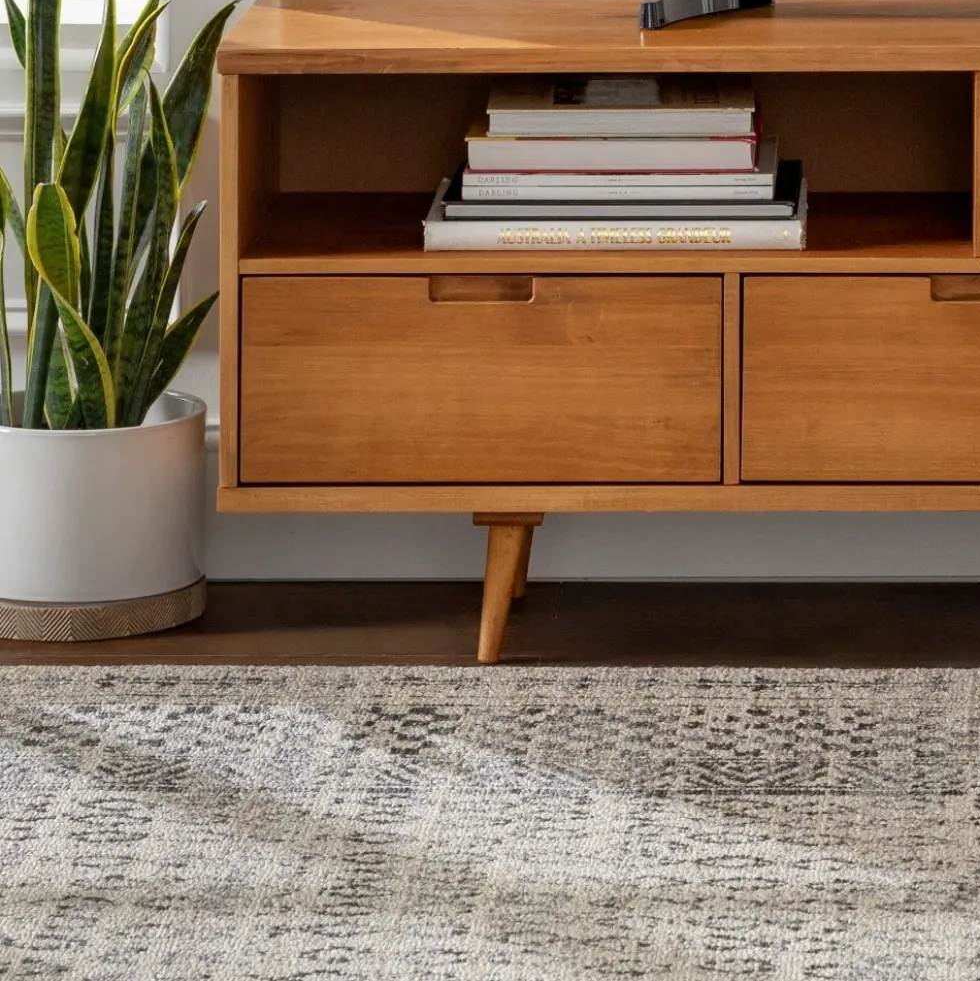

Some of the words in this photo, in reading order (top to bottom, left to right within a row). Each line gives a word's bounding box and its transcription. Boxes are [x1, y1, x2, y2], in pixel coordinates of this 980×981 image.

[478, 176, 519, 184] DARLING
[478, 189, 519, 197] DARLING
[497, 227, 571, 244] AUSTRALIA
[576, 227, 587, 244] A
[590, 227, 652, 244] TIMELESS
[657, 227, 731, 244] GRANDEUR
